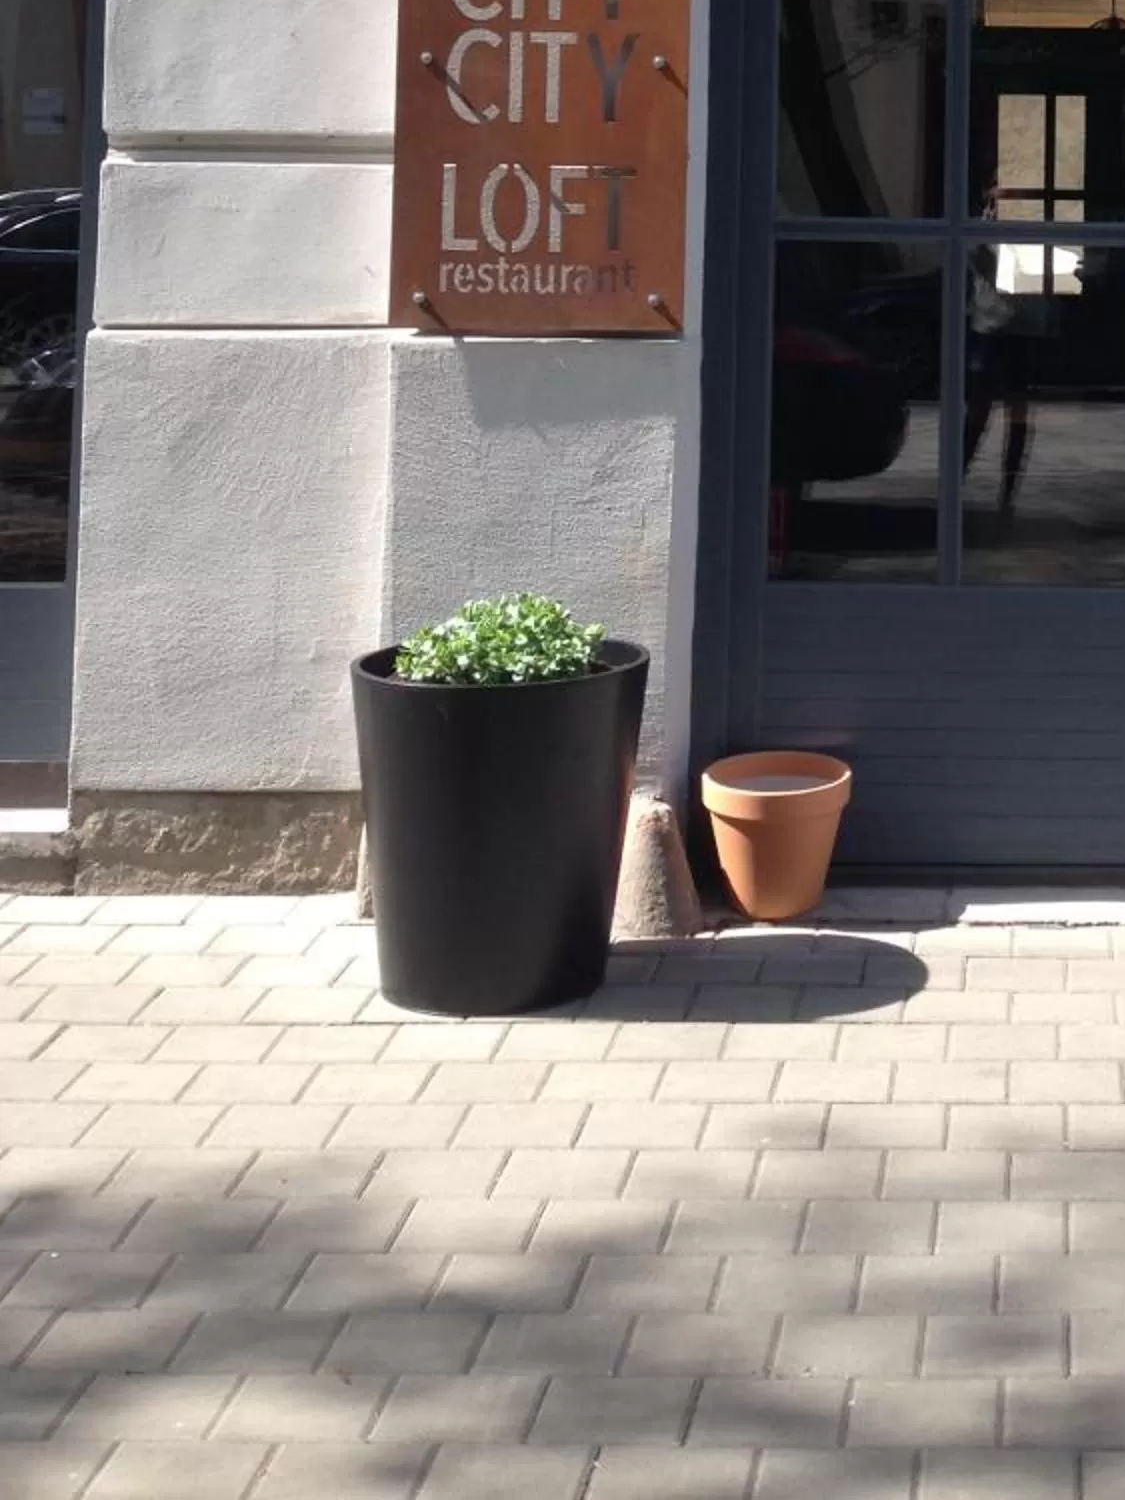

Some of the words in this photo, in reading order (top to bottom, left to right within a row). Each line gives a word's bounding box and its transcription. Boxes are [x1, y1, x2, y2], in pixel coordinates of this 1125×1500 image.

[446, 29, 639, 123] CITY
[441, 163, 637, 253] LOFT
[438, 257, 636, 295] restaurant
